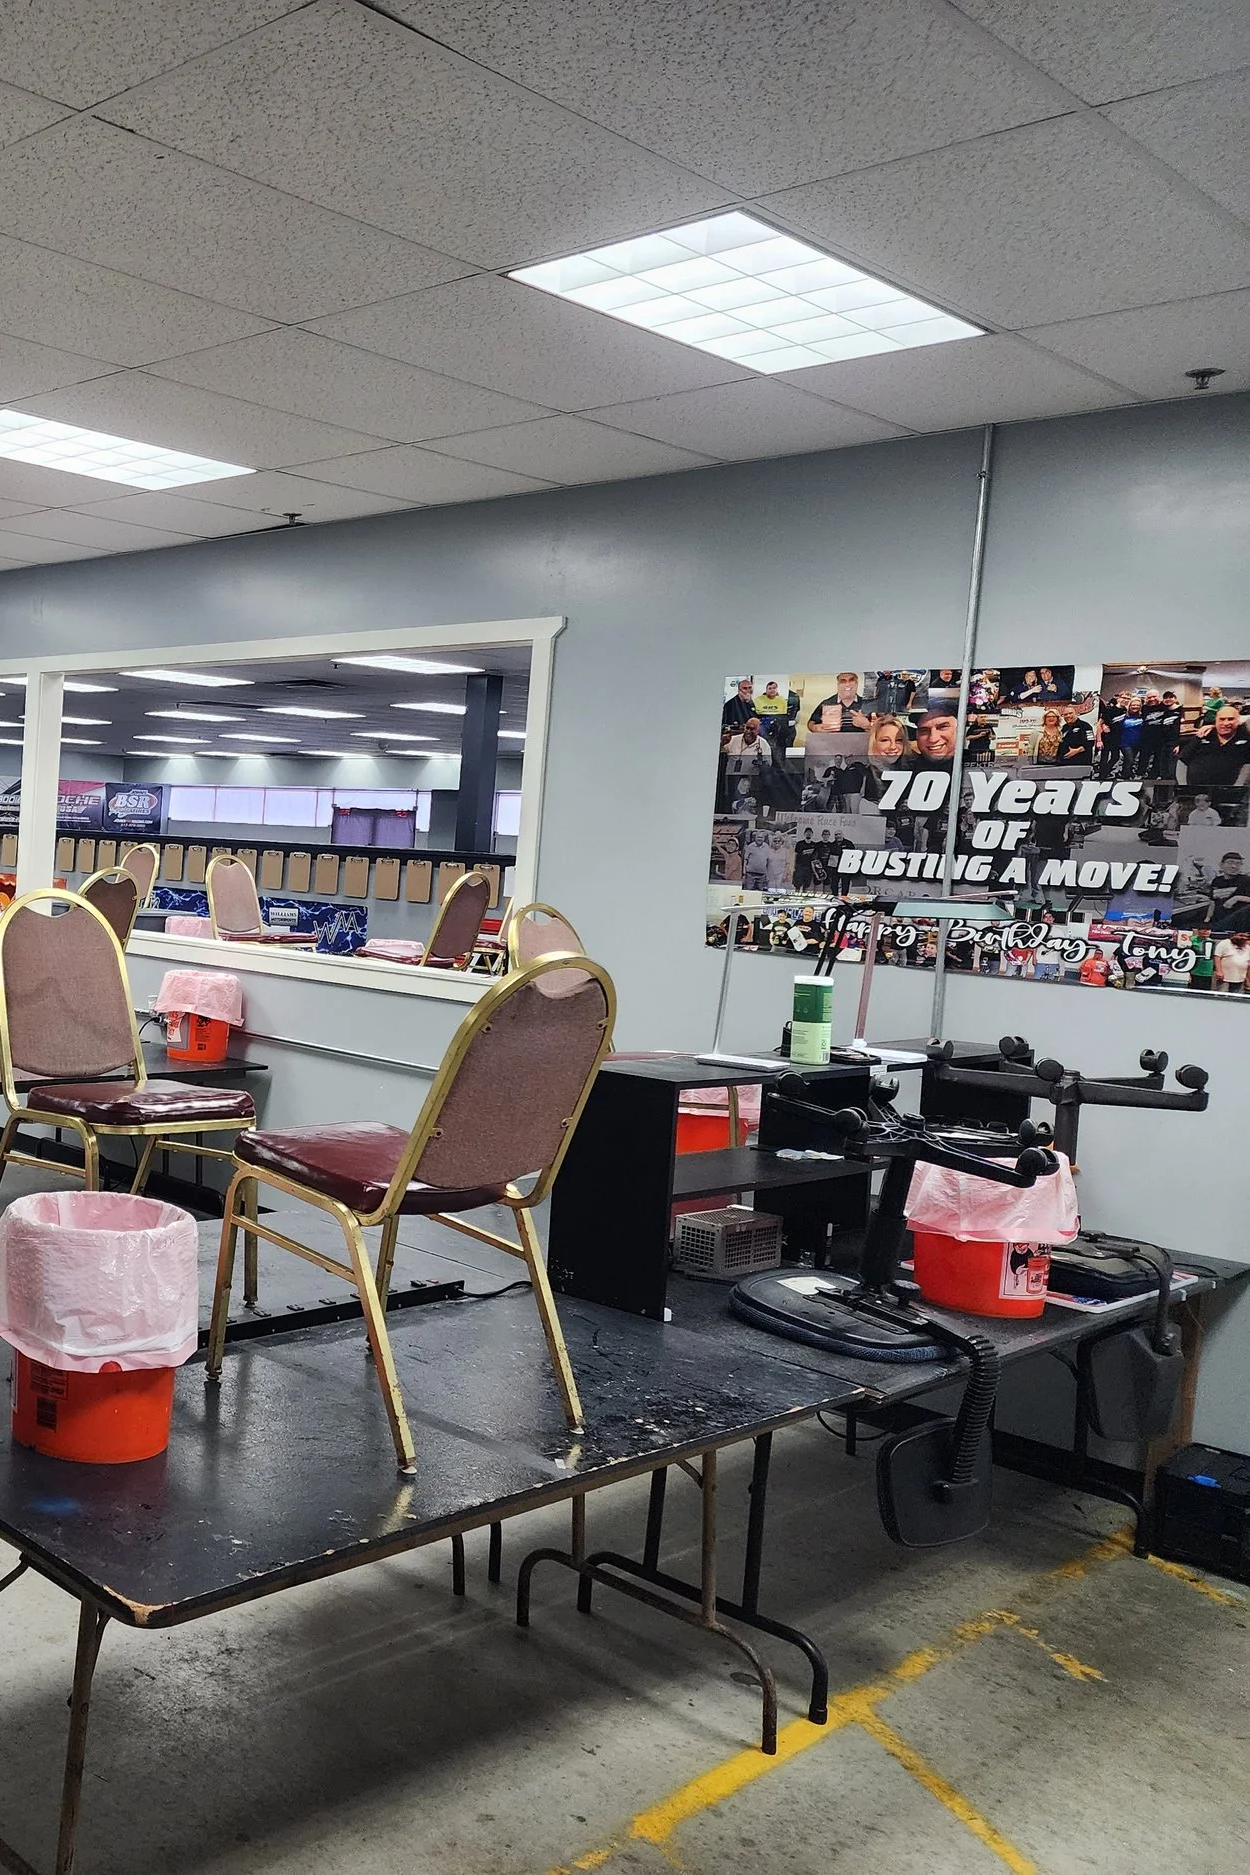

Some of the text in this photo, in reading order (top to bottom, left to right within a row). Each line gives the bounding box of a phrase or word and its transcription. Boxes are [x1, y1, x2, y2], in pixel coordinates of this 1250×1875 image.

[116, 794, 150, 808] BSR
[878, 770, 1144, 818] 70 Years
[972, 819, 1031, 851] OF
[837, 849, 1180, 893] BUSTING A MOVE!
[945, 918, 1097, 962] Birthday
[1112, 929, 1213, 972] Tony!
